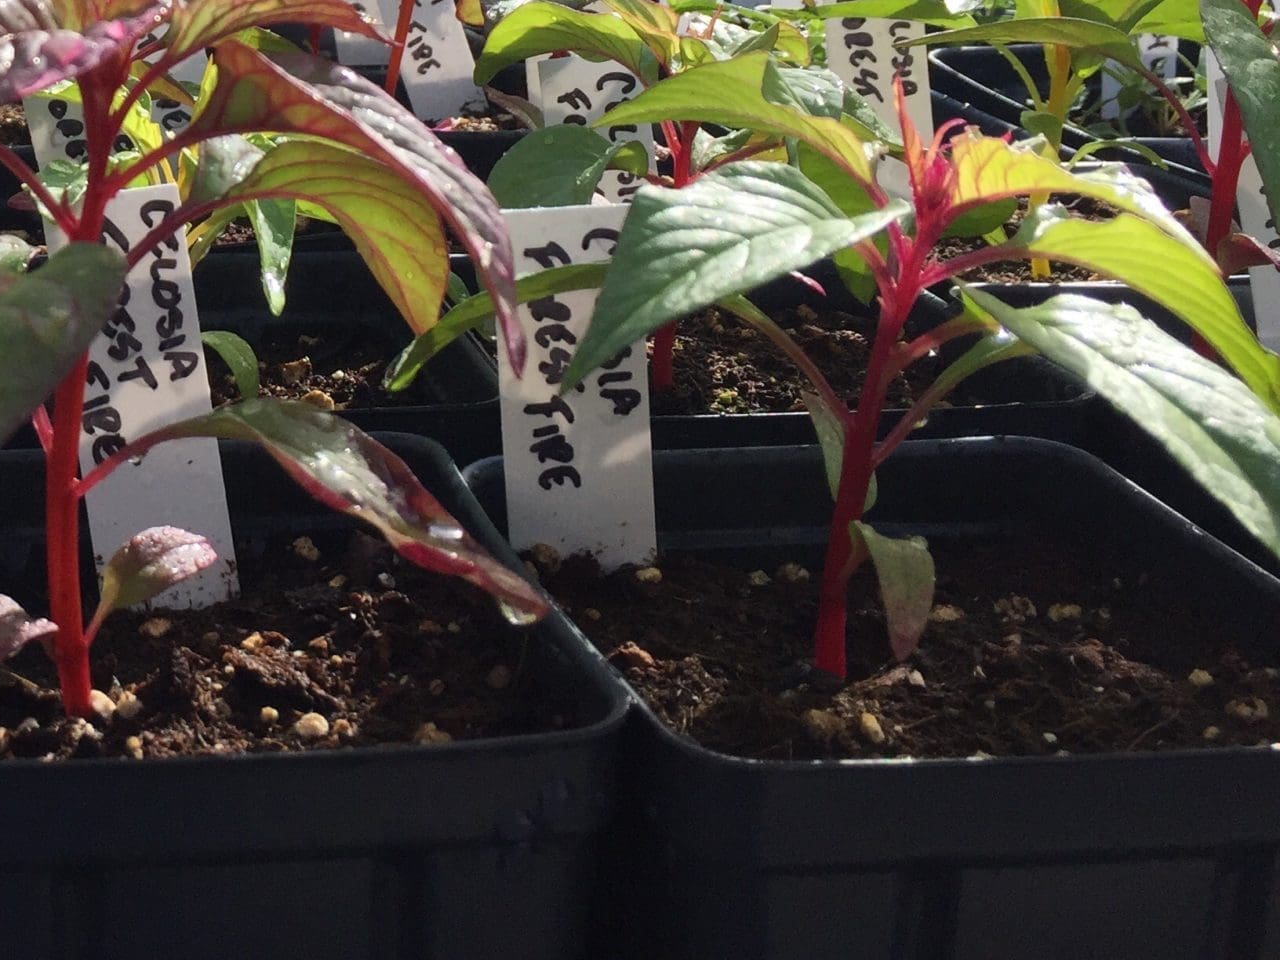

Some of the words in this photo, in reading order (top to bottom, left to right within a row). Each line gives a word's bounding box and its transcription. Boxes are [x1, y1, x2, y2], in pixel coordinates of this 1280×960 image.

[139, 199, 199, 382] CELOSIA
[81, 360, 127, 467] FIRE
[523, 395, 582, 491] FIRE
